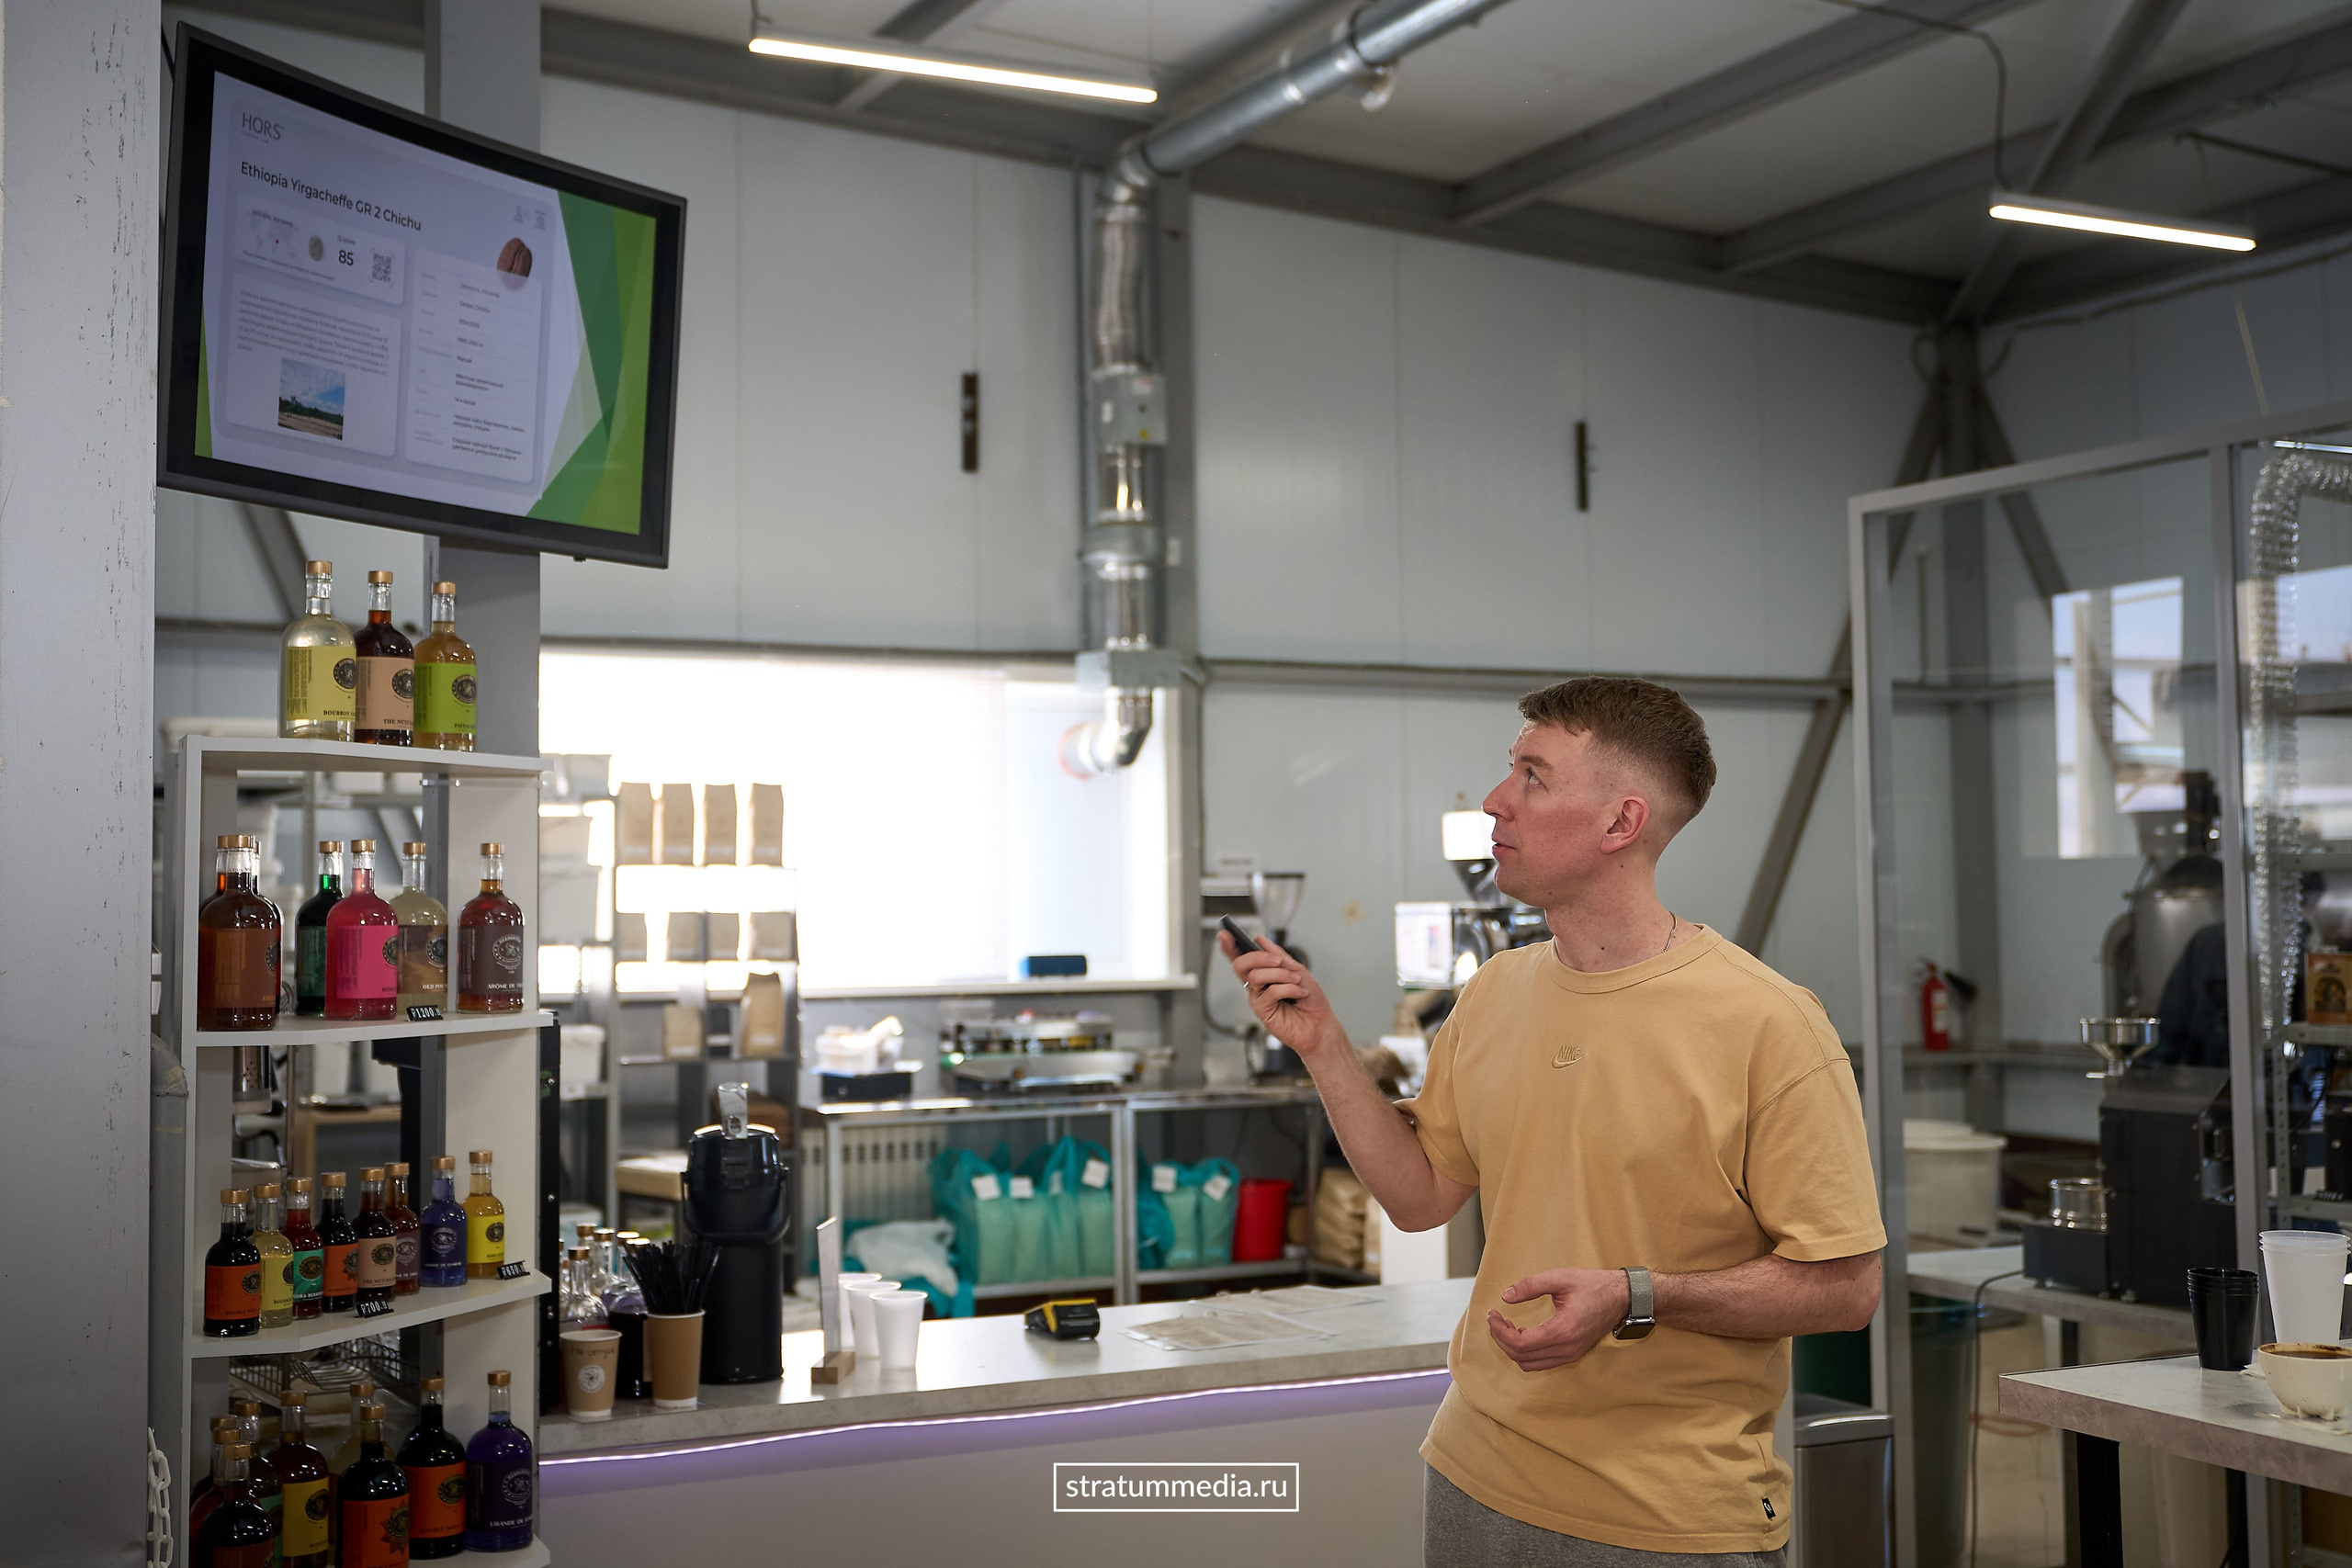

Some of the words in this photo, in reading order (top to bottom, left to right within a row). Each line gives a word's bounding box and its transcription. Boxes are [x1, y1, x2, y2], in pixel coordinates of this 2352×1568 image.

[242, 112, 281, 141] HORS
[241, 161, 288, 188] Ethiopia
[290, 178, 353, 209] Yirgacheffe
[356, 200, 371, 217] GR
[374, 206, 381, 220] 2
[382, 209, 422, 231] Chichu
[338, 250, 354, 266] 85
[1559, 1044, 1581, 1061] NIKE
